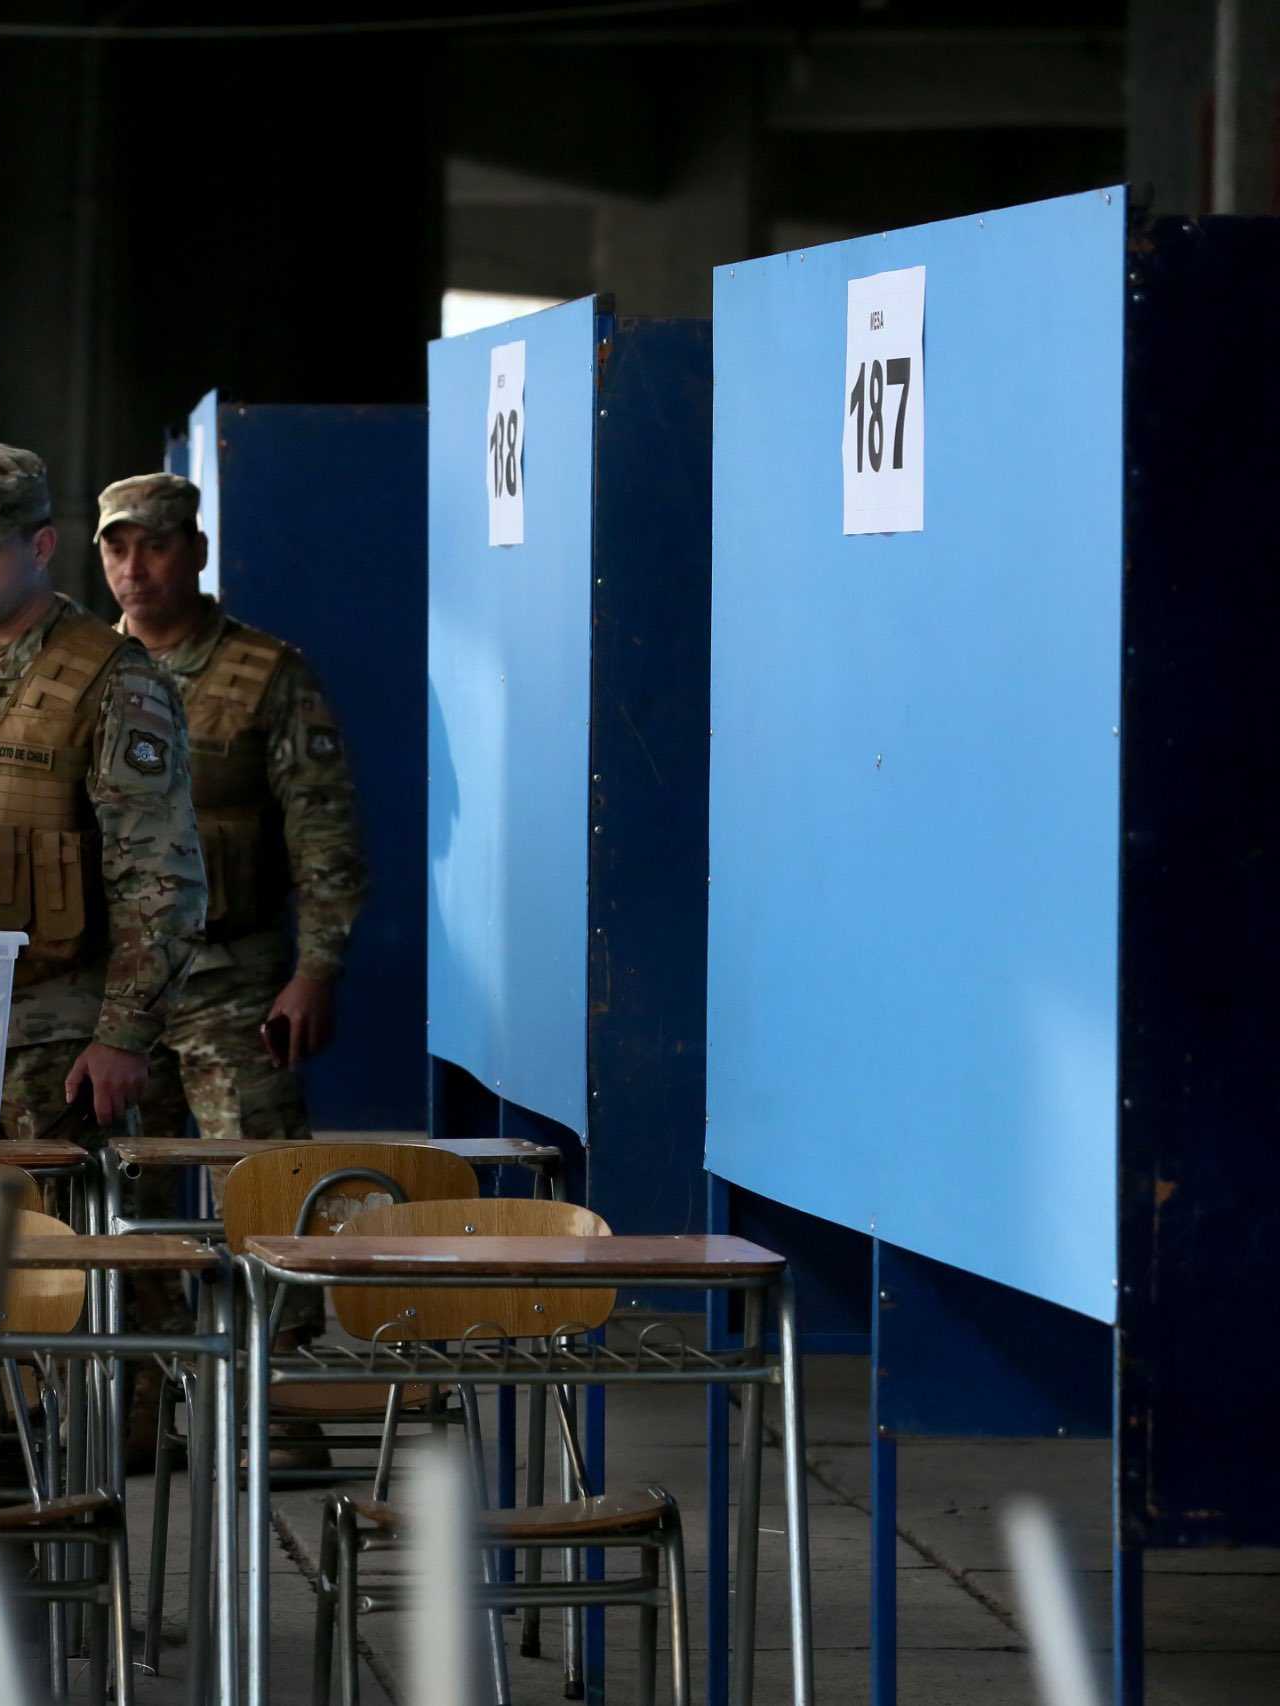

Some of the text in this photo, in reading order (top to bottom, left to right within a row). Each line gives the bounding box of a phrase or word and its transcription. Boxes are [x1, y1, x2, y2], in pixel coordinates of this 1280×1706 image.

[850, 357, 911, 473] 187
[15, 748, 26, 760] DE
[26, 749, 50, 764] CHILE
